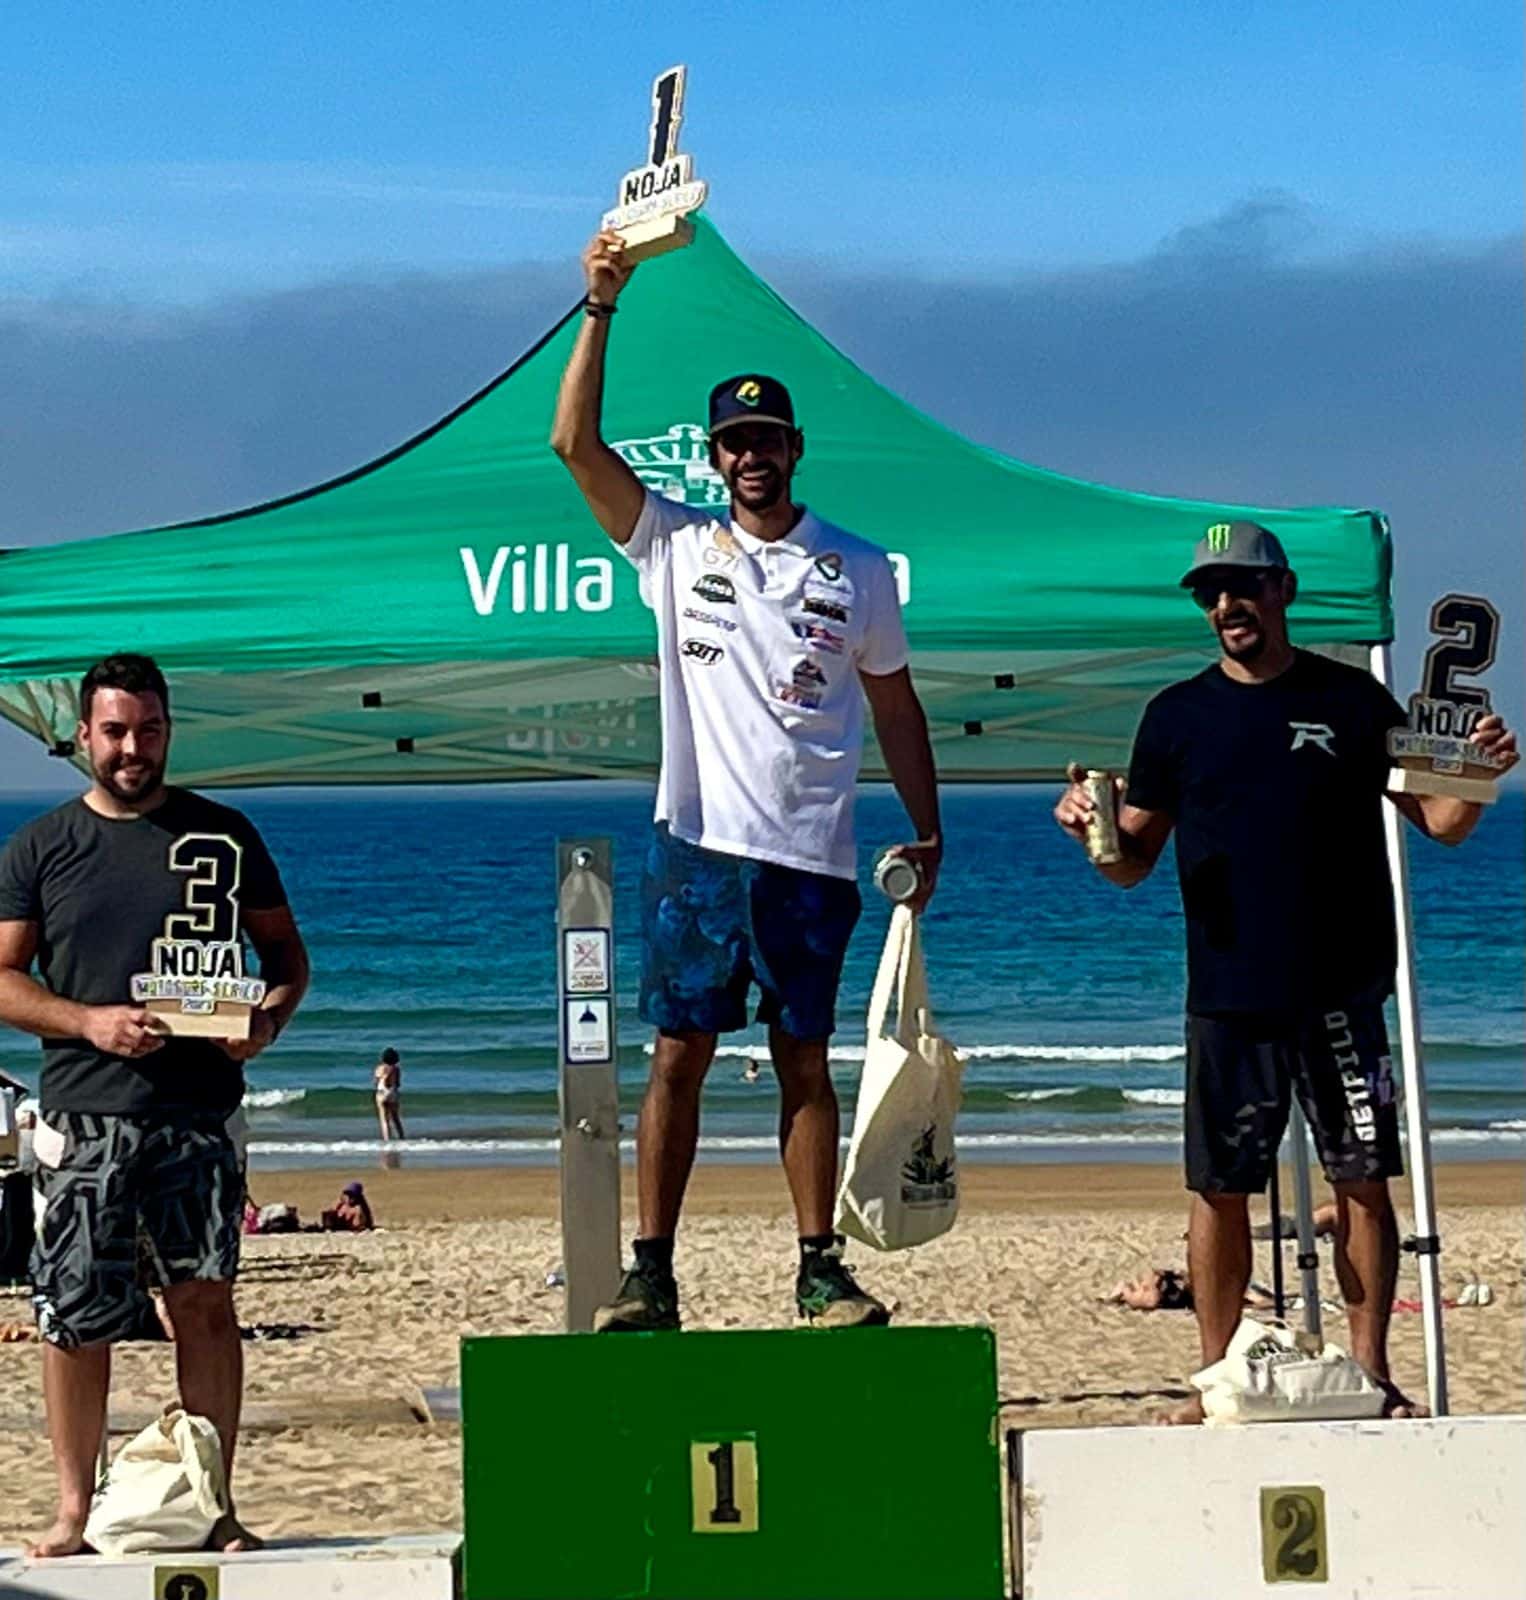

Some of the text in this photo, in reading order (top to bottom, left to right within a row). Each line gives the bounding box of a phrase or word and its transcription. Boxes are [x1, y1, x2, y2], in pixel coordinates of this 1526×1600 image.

[651, 69, 681, 168] 1
[624, 163, 681, 206] NOJA
[459, 543, 613, 616] Villa
[1421, 593, 1500, 708] 2
[165, 833, 244, 943] 3
[161, 944, 236, 978] NOJA
[708, 1440, 742, 1524] 1
[1272, 1493, 1318, 1577] 2
